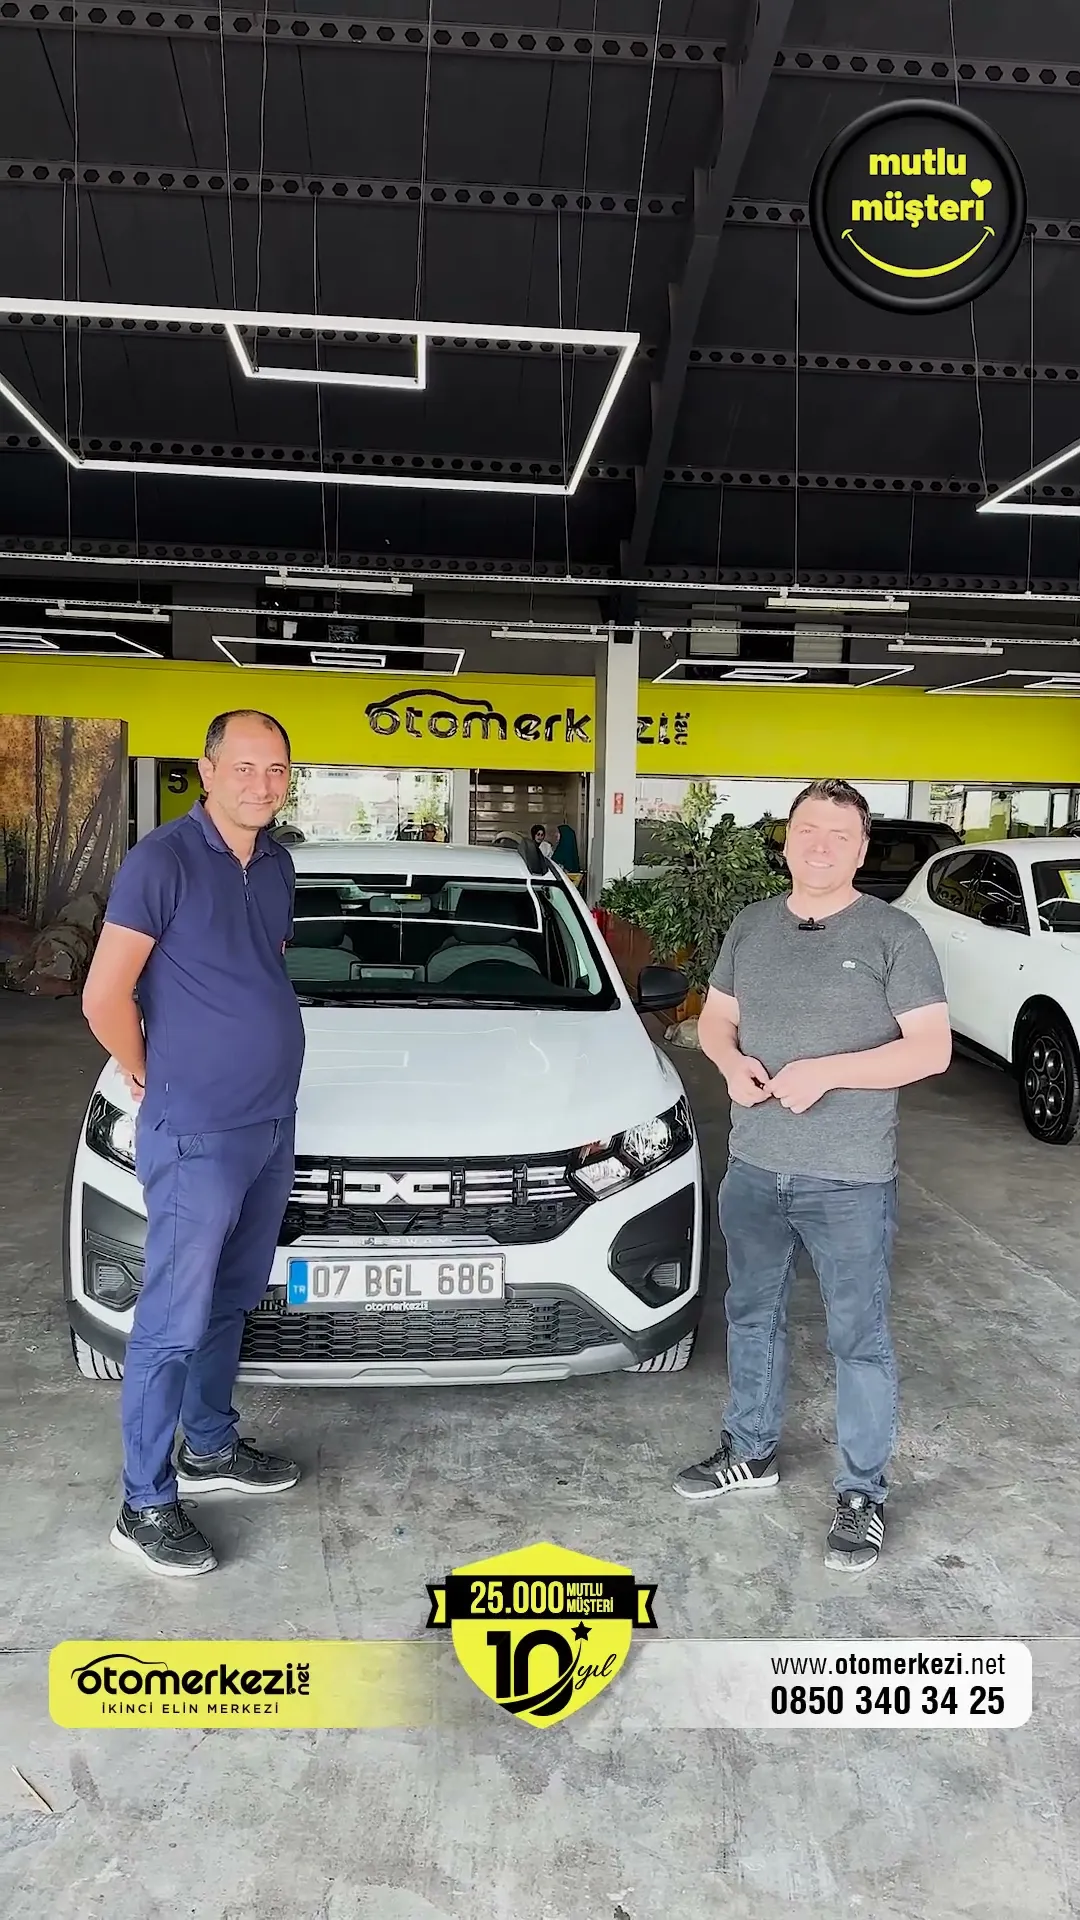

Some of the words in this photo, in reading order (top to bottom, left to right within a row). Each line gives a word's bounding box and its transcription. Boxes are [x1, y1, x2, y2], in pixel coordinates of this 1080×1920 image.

[168, 769, 188, 794] 5
[293, 1284, 306, 1294] TR
[312, 1265, 351, 1298] 07
[365, 1264, 422, 1297] BGL
[438, 1262, 495, 1295] 686
